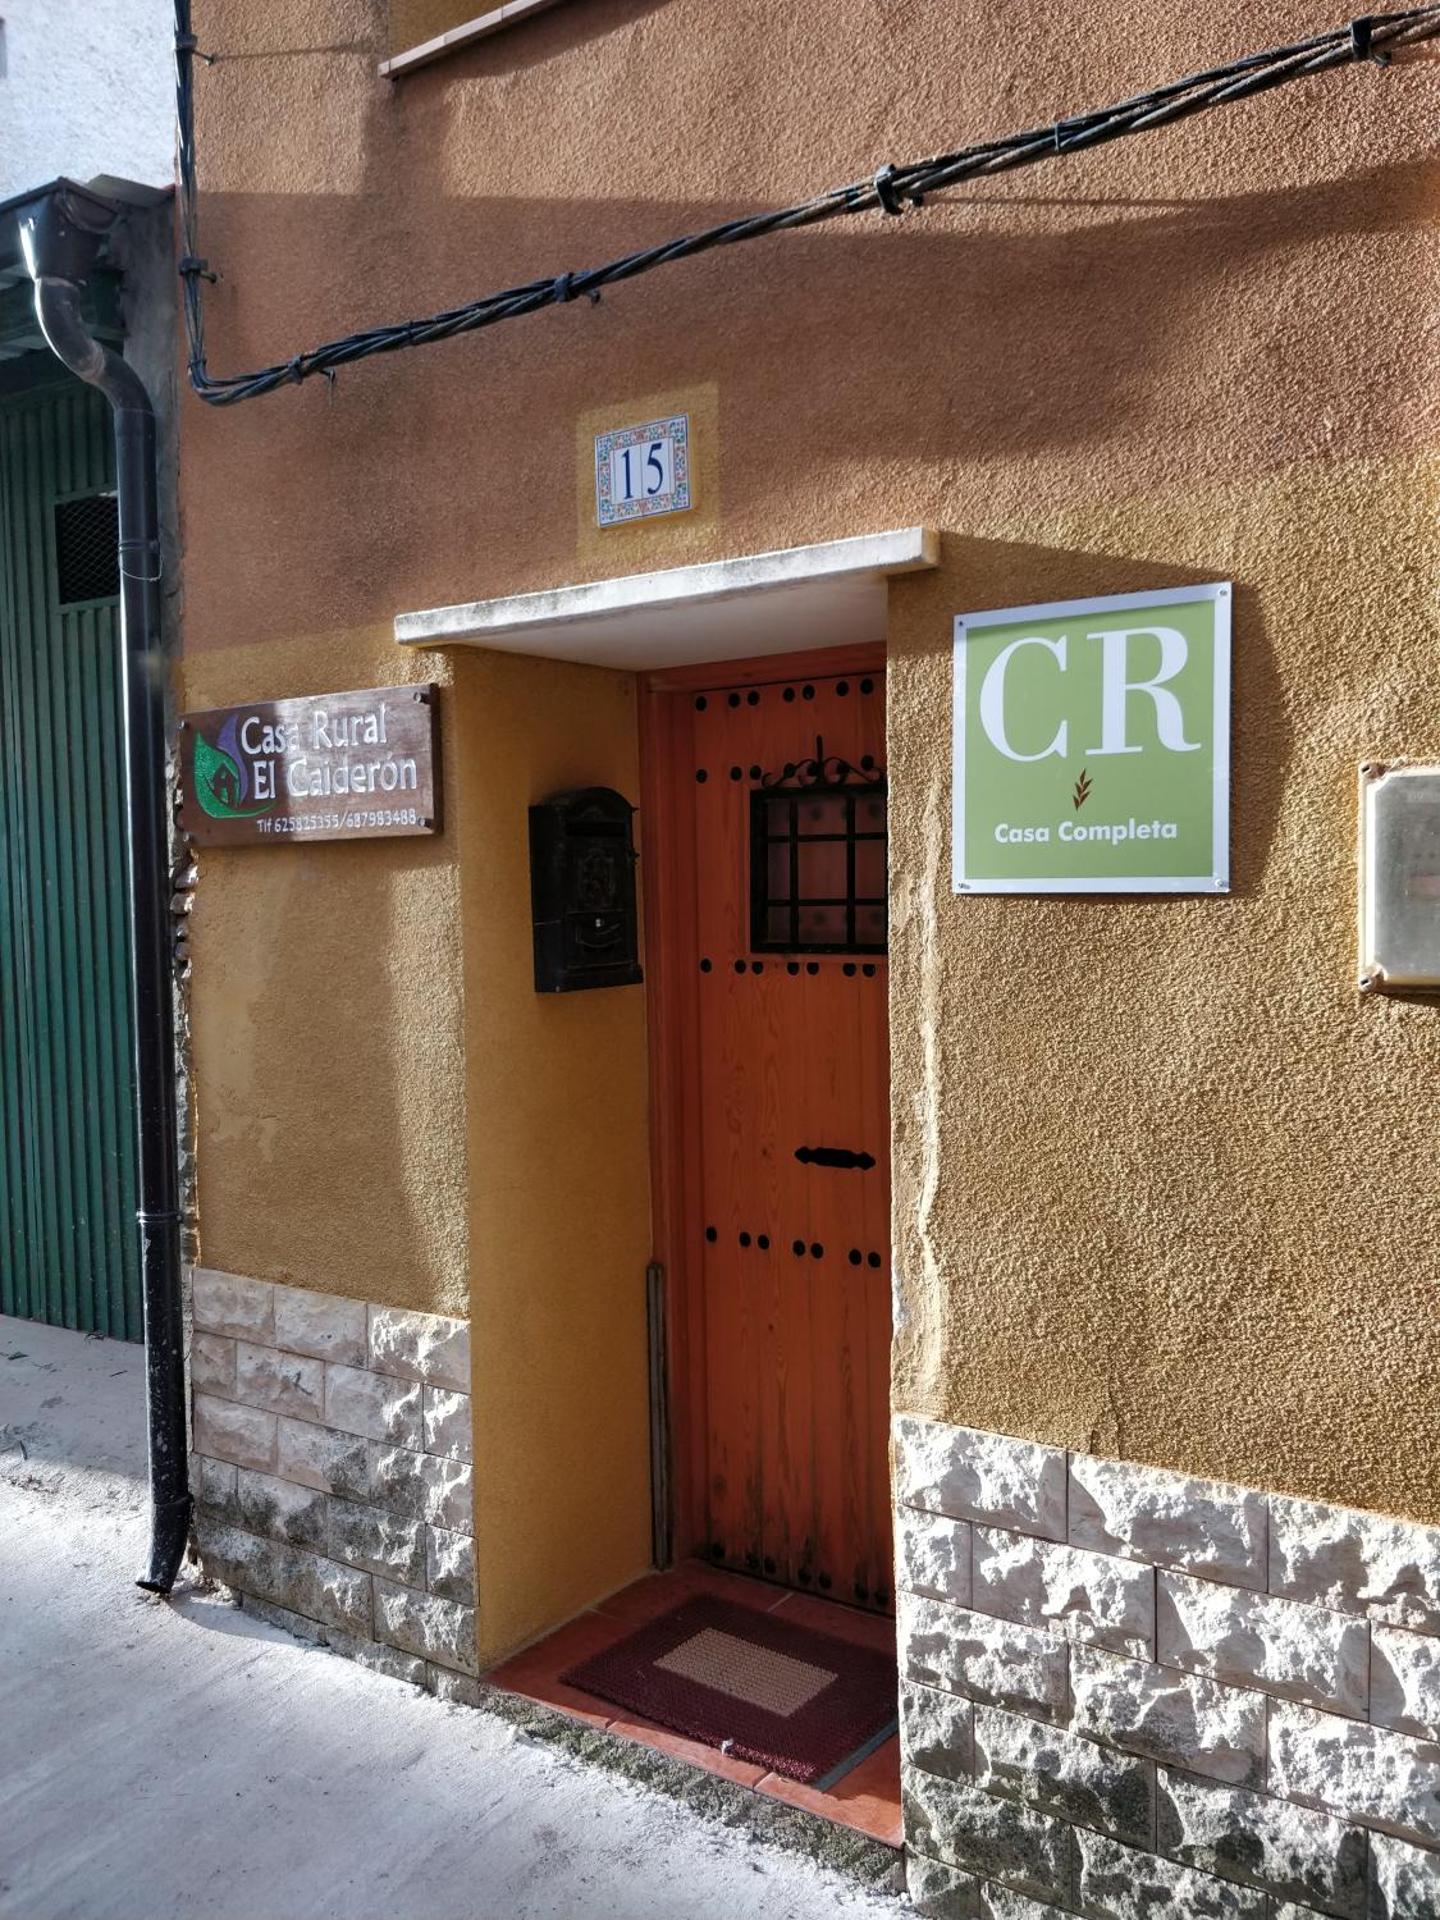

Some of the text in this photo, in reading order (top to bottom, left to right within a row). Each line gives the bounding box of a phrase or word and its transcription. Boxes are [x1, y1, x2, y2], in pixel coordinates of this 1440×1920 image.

[621, 442, 663, 499] 15
[980, 626, 1202, 762] CR
[241, 703, 388, 755] Casa Rural
[253, 753, 417, 800] El Calderón
[256, 818, 272, 833] Tlf
[994, 818, 1178, 845] Casa Completa
